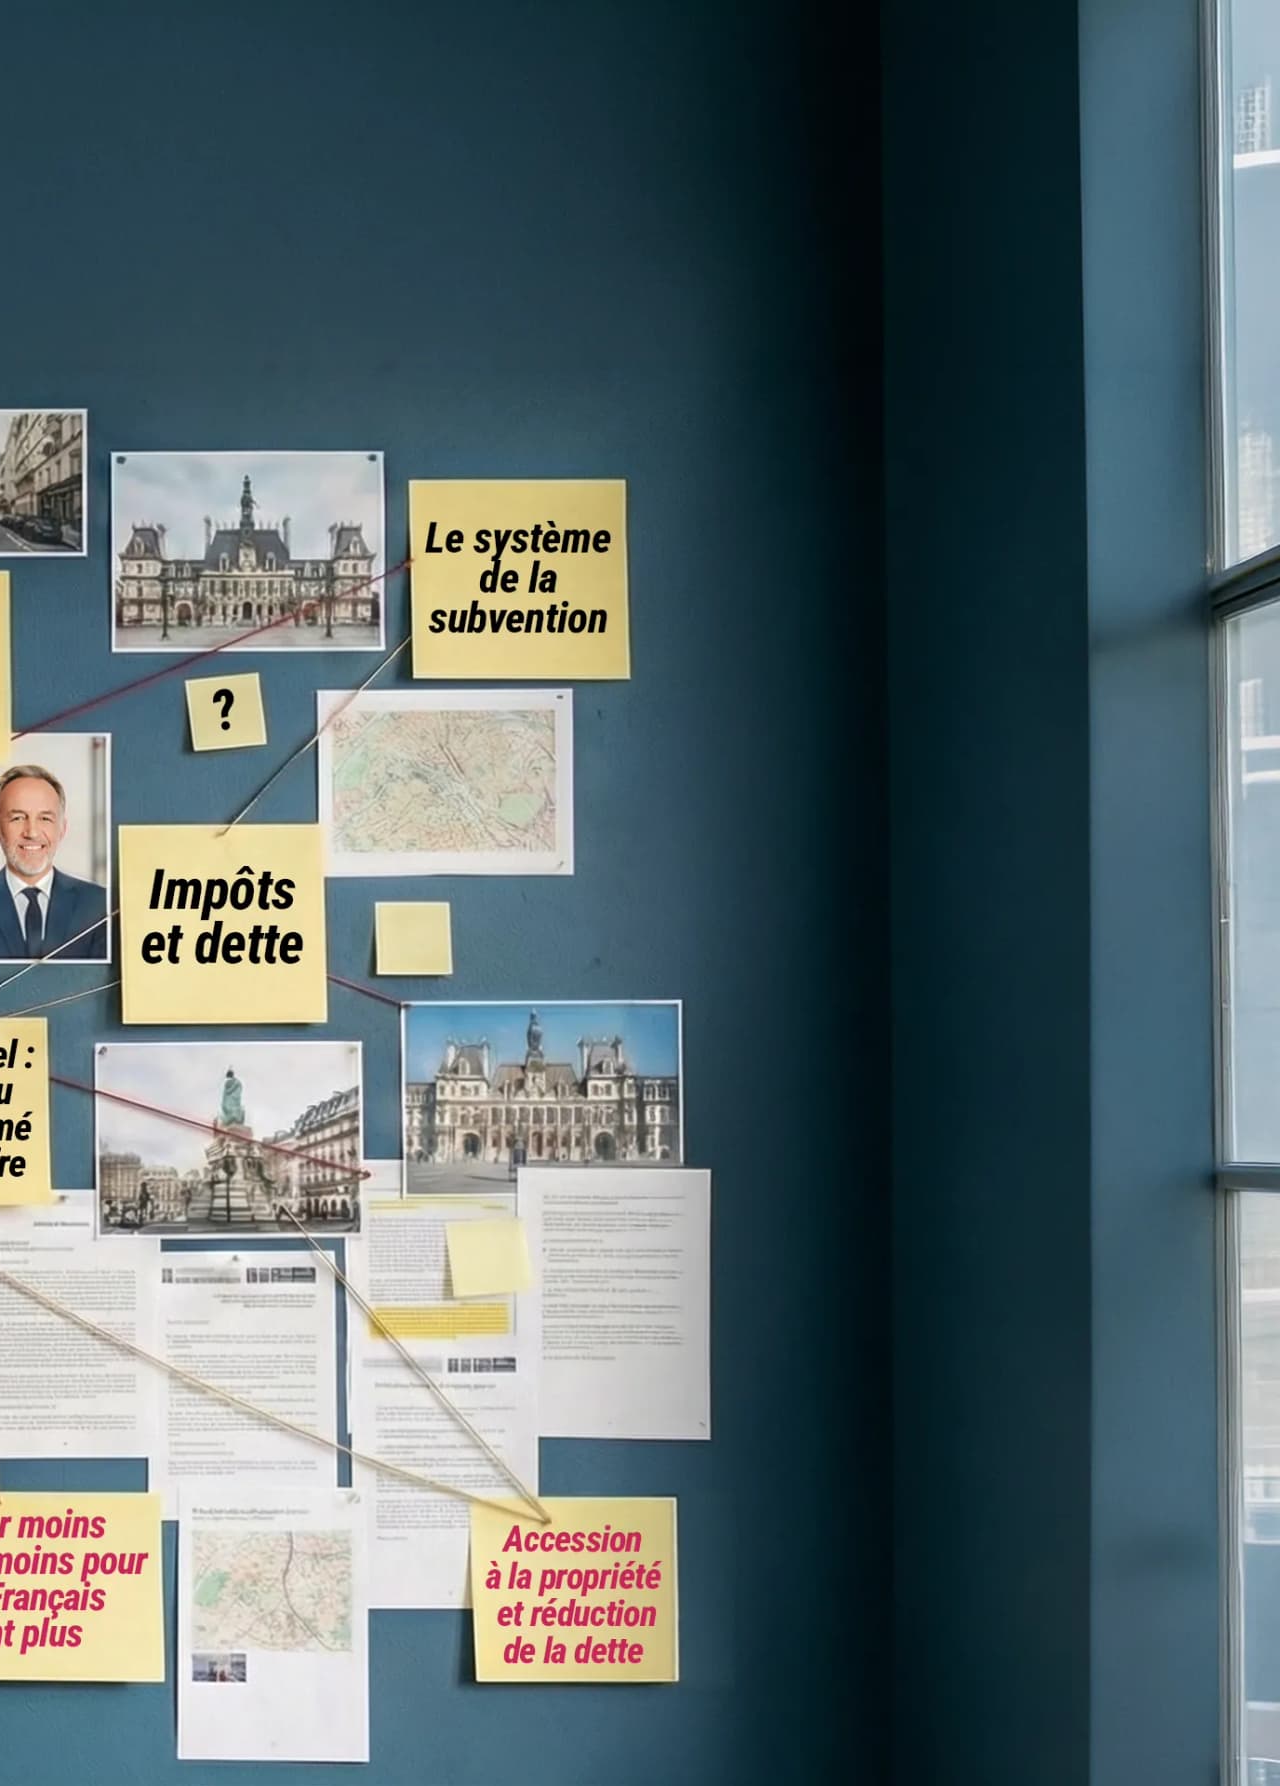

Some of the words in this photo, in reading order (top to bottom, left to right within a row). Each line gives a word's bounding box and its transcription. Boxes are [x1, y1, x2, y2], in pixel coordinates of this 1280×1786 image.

[425, 521, 464, 553] Le
[473, 520, 611, 562] système
[480, 560, 518, 592] de
[528, 560, 557, 594] la
[428, 600, 608, 634] subvention
[212, 688, 234, 731] ?
[149, 865, 296, 921] Impôts
[141, 925, 184, 965] et
[195, 920, 303, 965] dette
[17, 1508, 106, 1538] moins
[502, 1525, 641, 1552] Accession
[80, 1552, 148, 1582] pour
[485, 1560, 501, 1589] à
[508, 1562, 532, 1589] la
[538, 1560, 662, 1597] propriété
[498, 1601, 524, 1627] et
[530, 1598, 657, 1627] réduction
[19, 1616, 83, 1655] plus
[504, 1636, 536, 1665] de
[543, 1636, 567, 1665] la
[574, 1636, 644, 1664] dette
